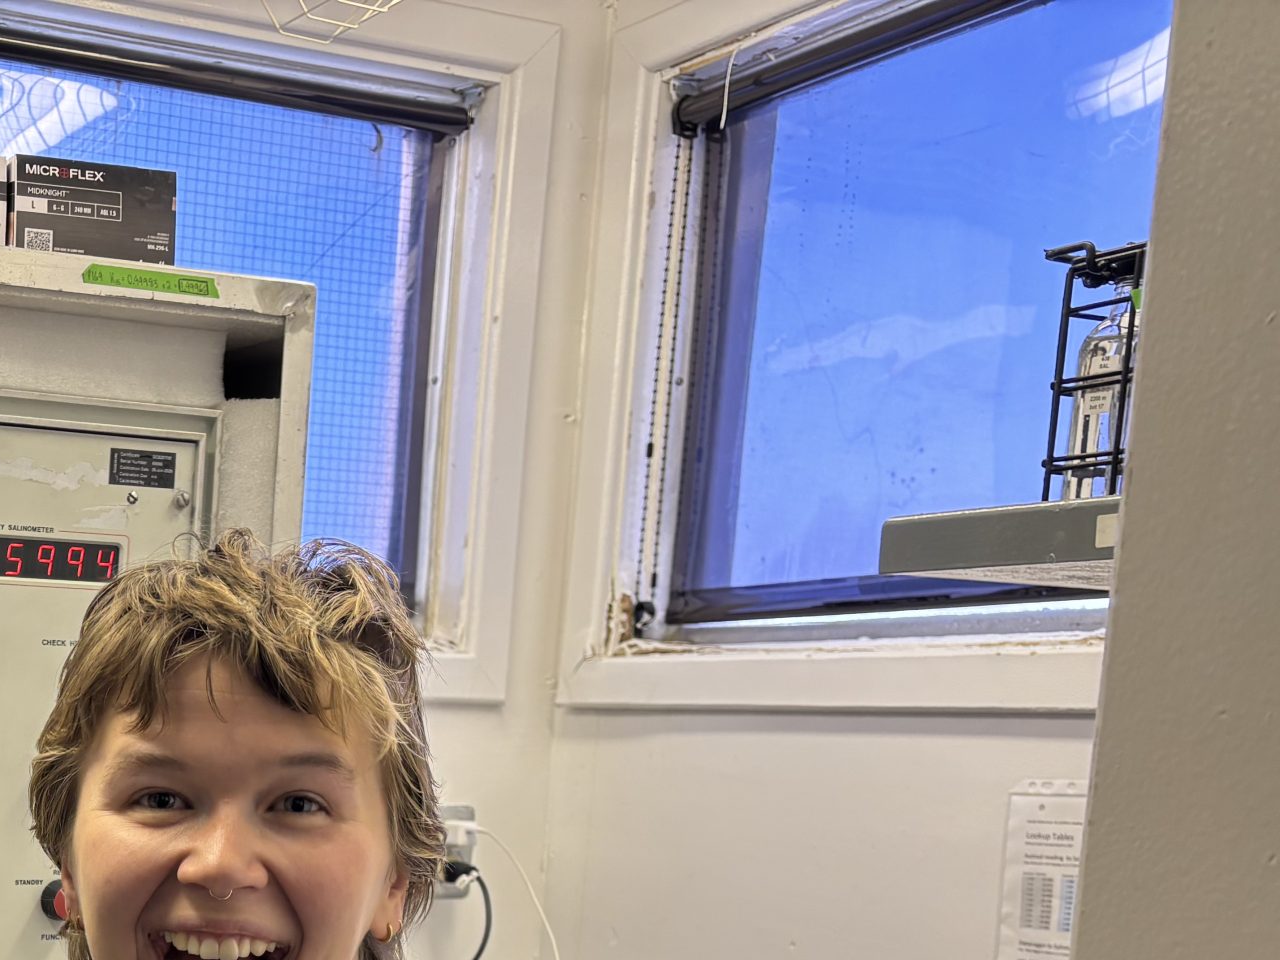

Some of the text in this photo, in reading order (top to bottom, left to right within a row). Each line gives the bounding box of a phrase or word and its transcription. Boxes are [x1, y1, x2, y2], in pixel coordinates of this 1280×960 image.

[27, 186, 67, 198] MIDKNIGHT
[7, 524, 55, 534] SALINOMETER
[41, 638, 67, 647] CHECK
